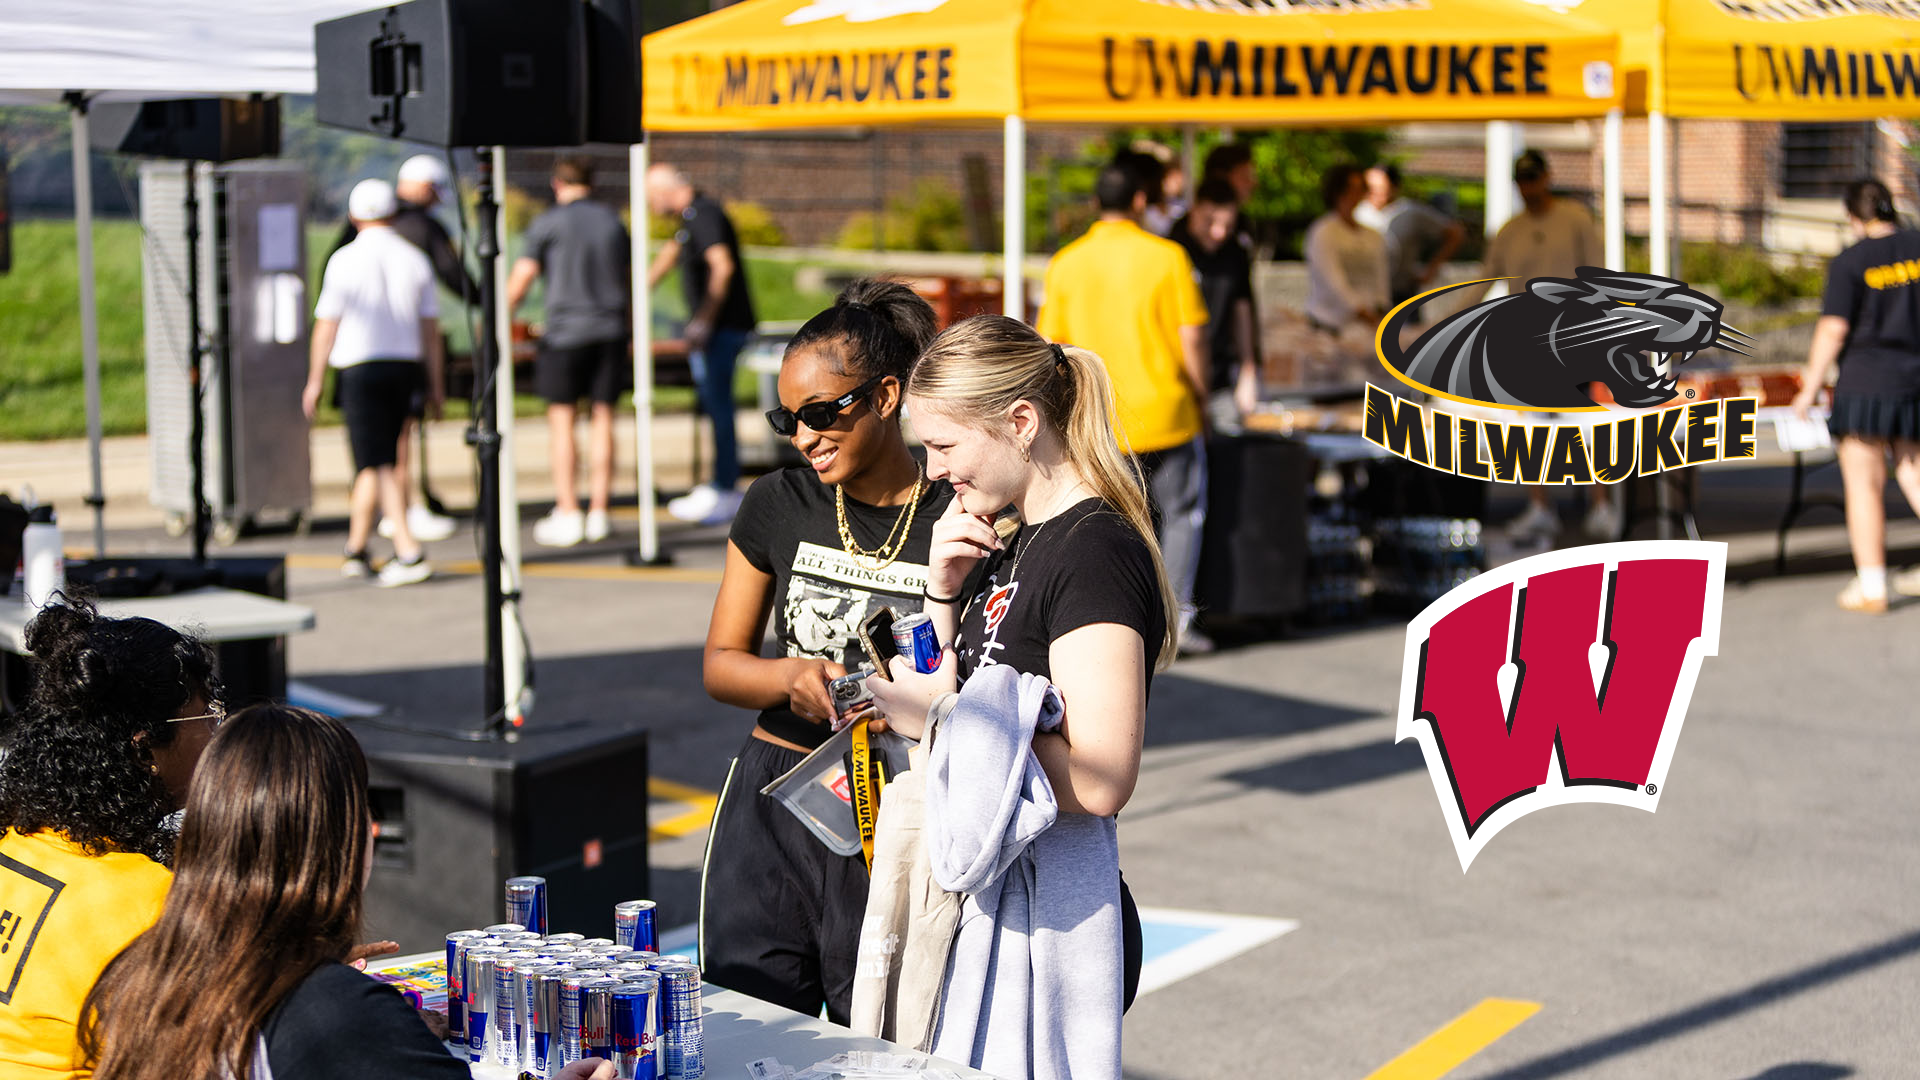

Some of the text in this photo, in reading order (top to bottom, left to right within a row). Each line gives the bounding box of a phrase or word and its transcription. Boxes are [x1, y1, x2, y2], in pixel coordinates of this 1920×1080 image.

[797, 556, 828, 571] ALL
[833, 563, 897, 585] THINGS
[615, 1029, 657, 1046] Red Bul
